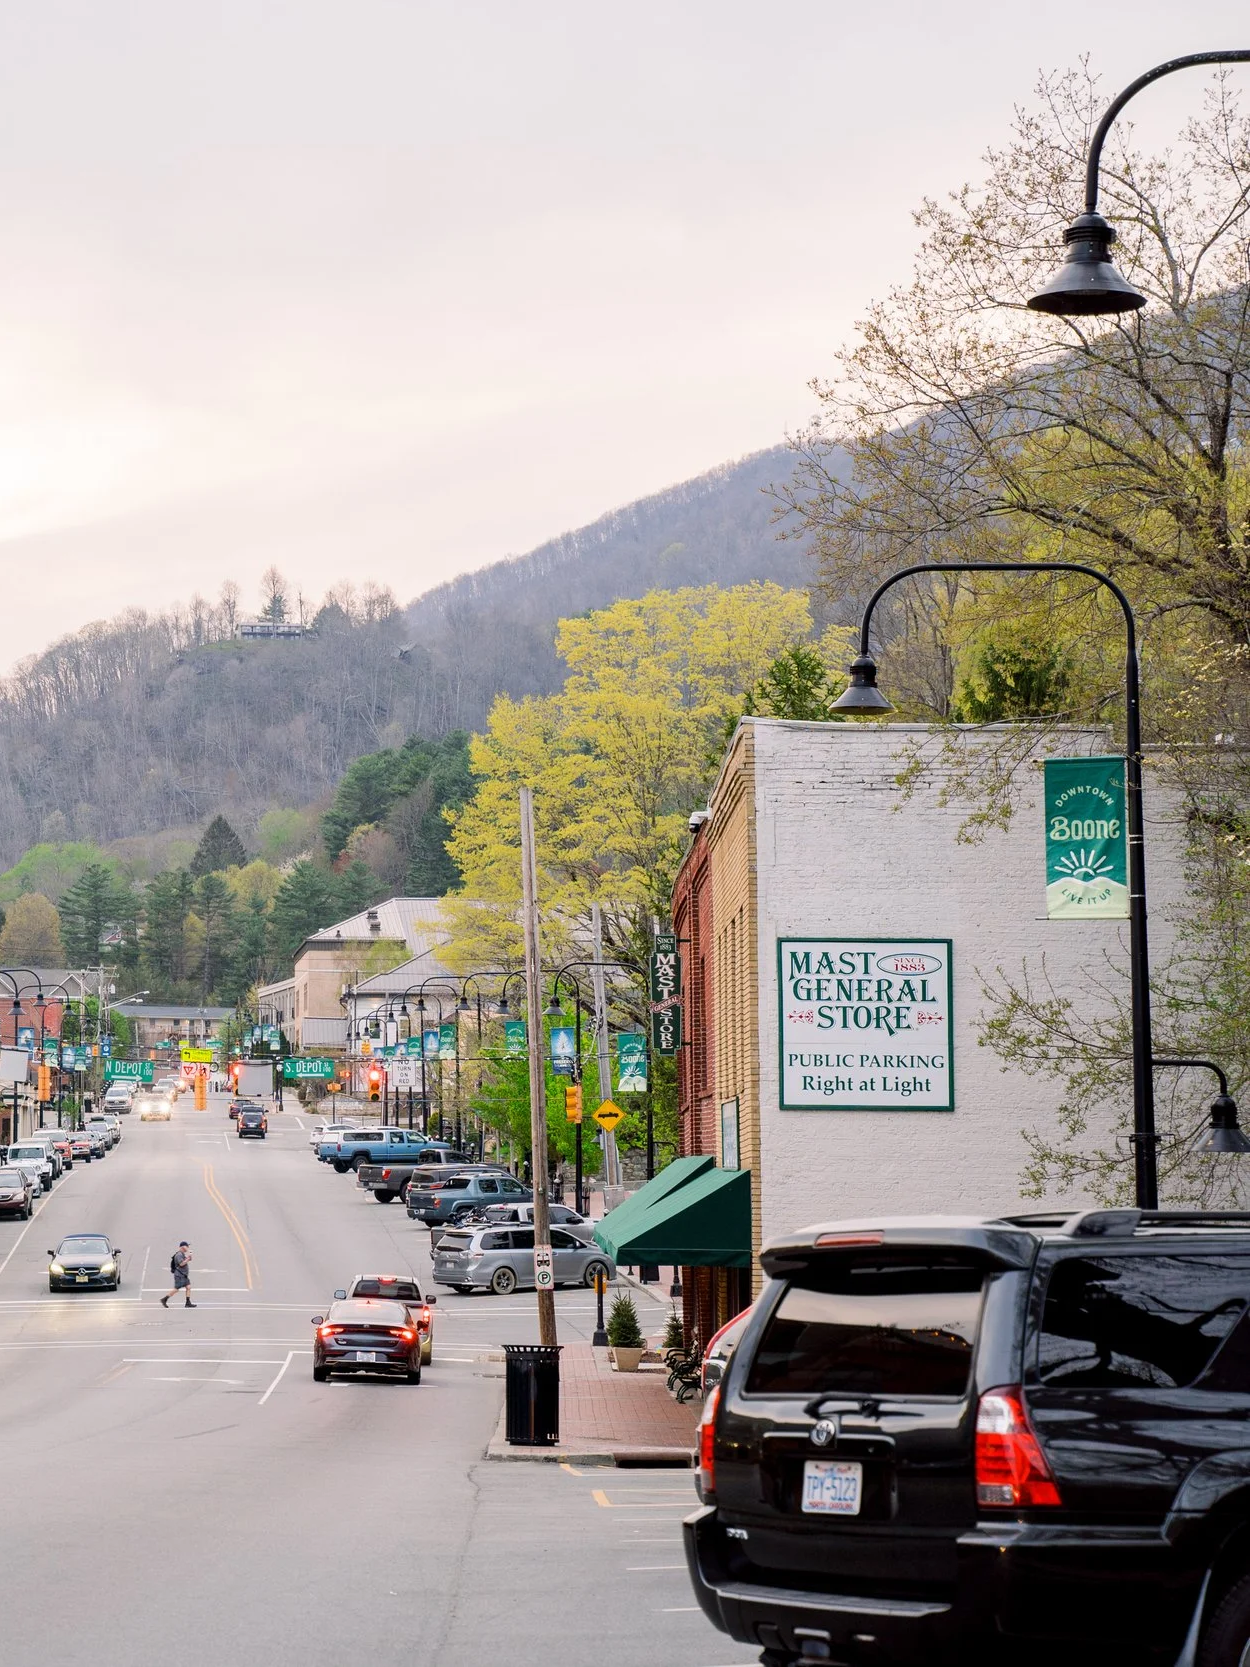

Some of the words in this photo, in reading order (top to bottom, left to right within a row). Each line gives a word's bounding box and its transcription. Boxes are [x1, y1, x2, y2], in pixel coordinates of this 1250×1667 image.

[1055, 785, 1114, 807] DOWNTOWN
[1050, 816, 1120, 840] Boone
[1062, 889, 1083, 904] LIVE
[1099, 888, 1112, 900] UP
[655, 953, 676, 999] MAST
[789, 952, 876, 981] MAST
[894, 964, 926, 972] 1883
[792, 978, 937, 1004] GENERAL
[654, 996, 679, 1012] GENERAL
[659, 1009, 673, 1049] STORE
[817, 1005, 912, 1036] STORE
[106, 1061, 111, 1072] N
[115, 1061, 142, 1074] DEPOT
[286, 1062, 294, 1072] S.
[296, 1061, 322, 1073] DEPOT
[788, 1054, 855, 1068] PUBLIC
[860, 1055, 945, 1069] PARKING
[802, 1075, 853, 1096] Right
[859, 1078, 876, 1091] at
[882, 1076, 931, 1097] Light
